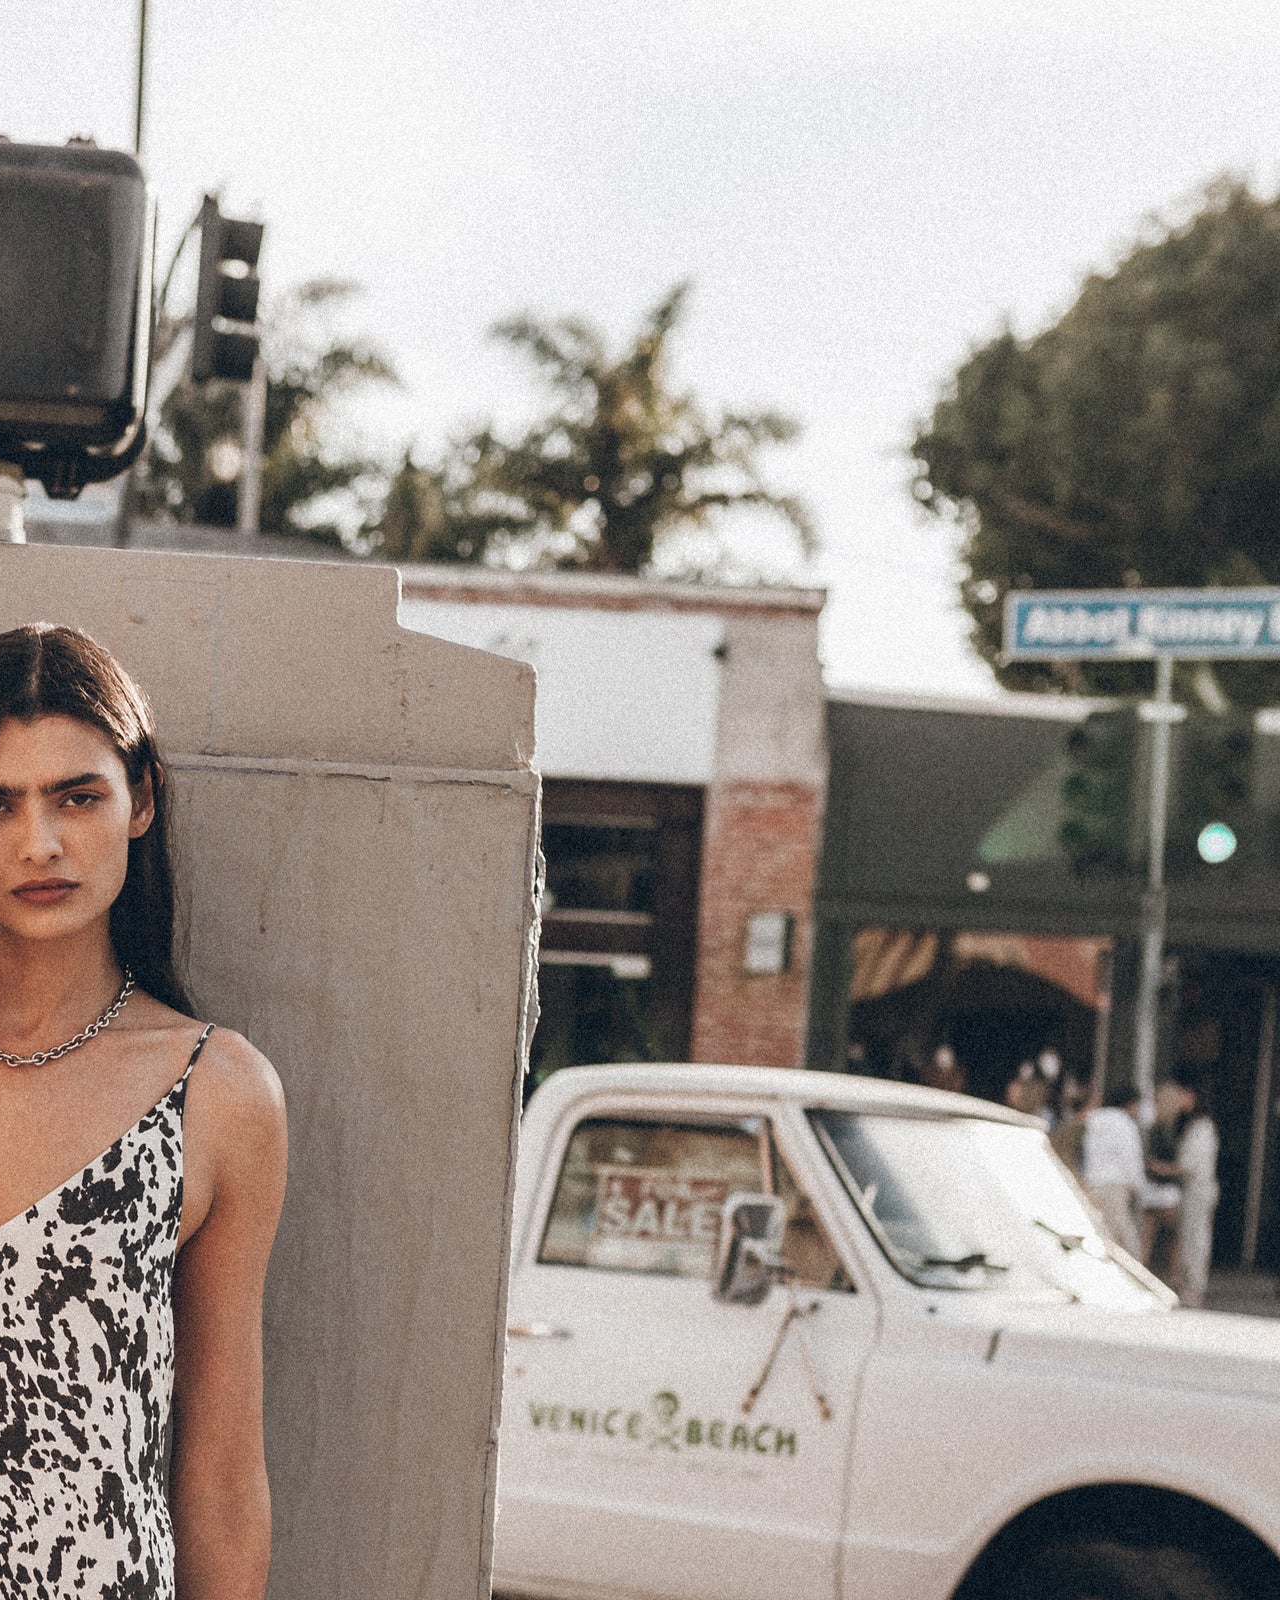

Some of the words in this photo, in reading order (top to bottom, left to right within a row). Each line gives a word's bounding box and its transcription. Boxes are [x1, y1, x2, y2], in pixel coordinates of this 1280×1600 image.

[601, 1198, 717, 1240] SALE
[528, 1400, 643, 1440] VENICE
[686, 1418, 798, 1456] BEACH
